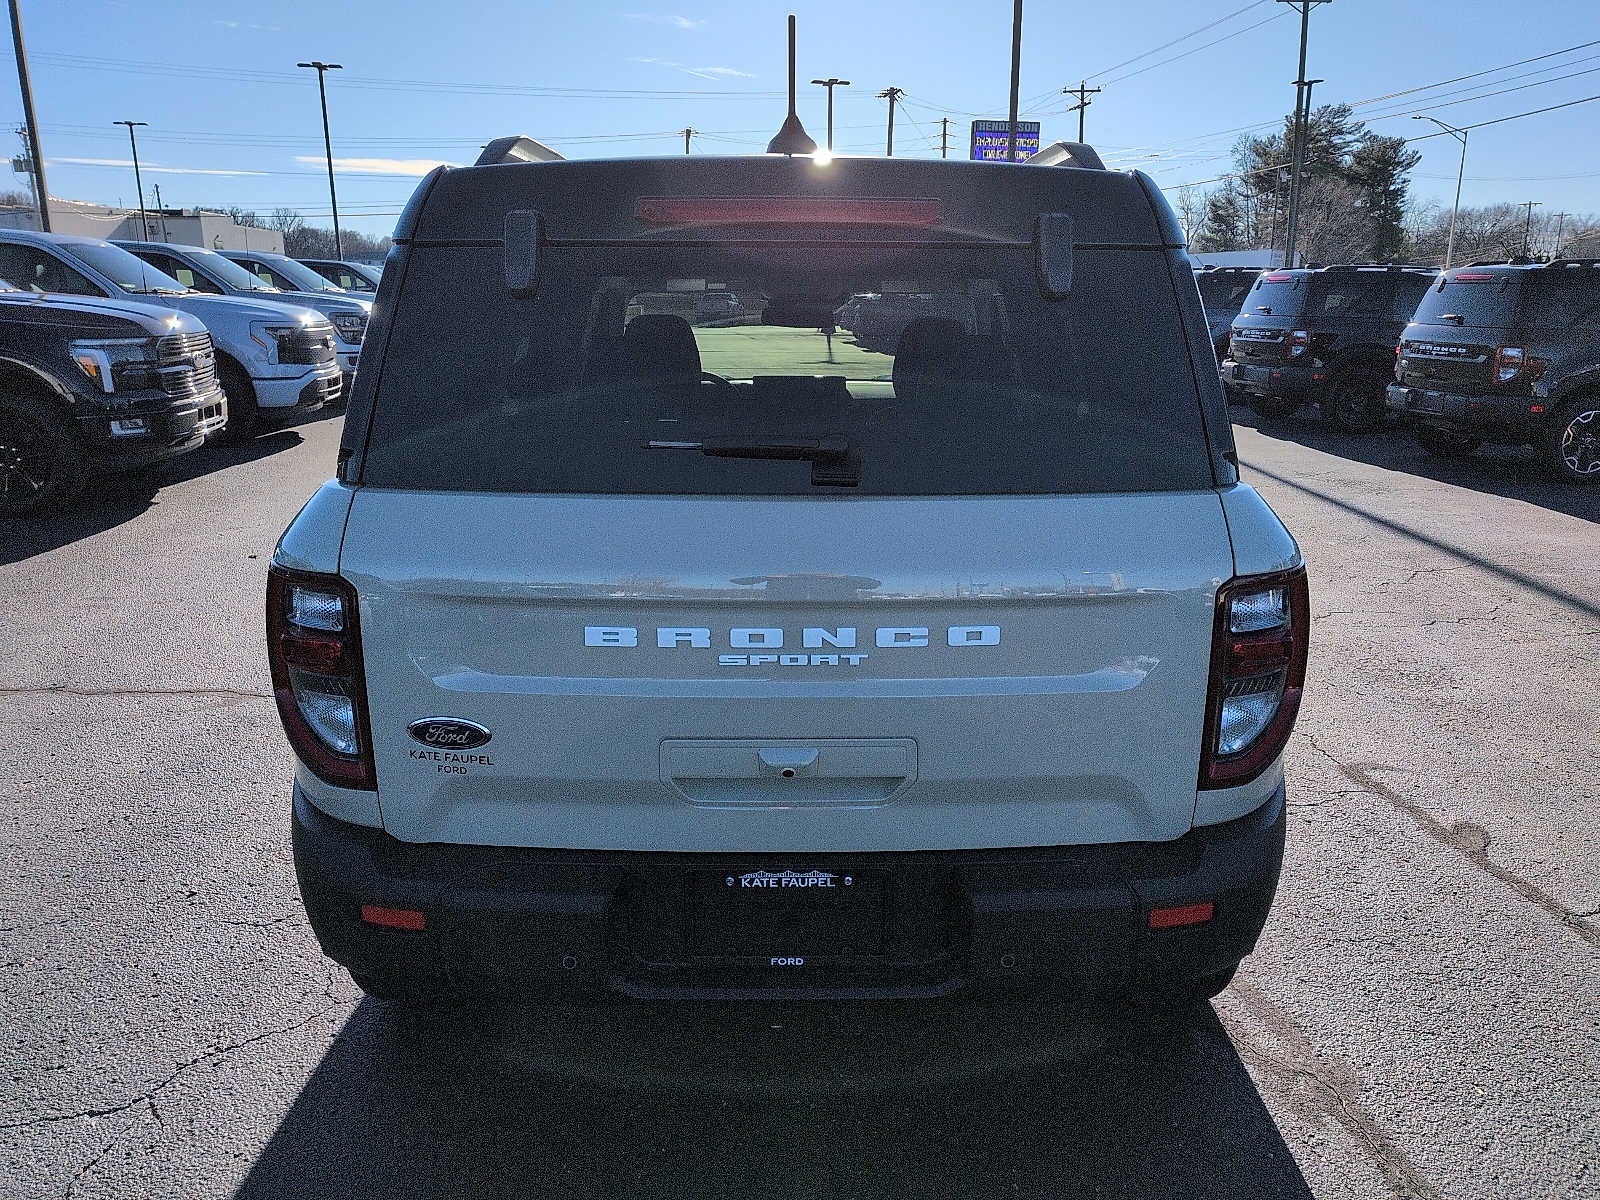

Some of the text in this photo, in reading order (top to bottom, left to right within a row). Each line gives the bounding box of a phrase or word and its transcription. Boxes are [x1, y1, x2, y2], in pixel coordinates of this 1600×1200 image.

[979, 121, 1039, 132] HENDESON
[1419, 343, 1467, 353] BRONCO
[584, 625, 1001, 649] BRONCO
[718, 653, 869, 667] SPORT
[425, 723, 470, 744] Ford
[409, 750, 494, 766] KATE FAUPEL
[437, 764, 468, 775] FORD
[741, 877, 836, 888] KATE FAUPEL
[770, 957, 804, 966] FORD
